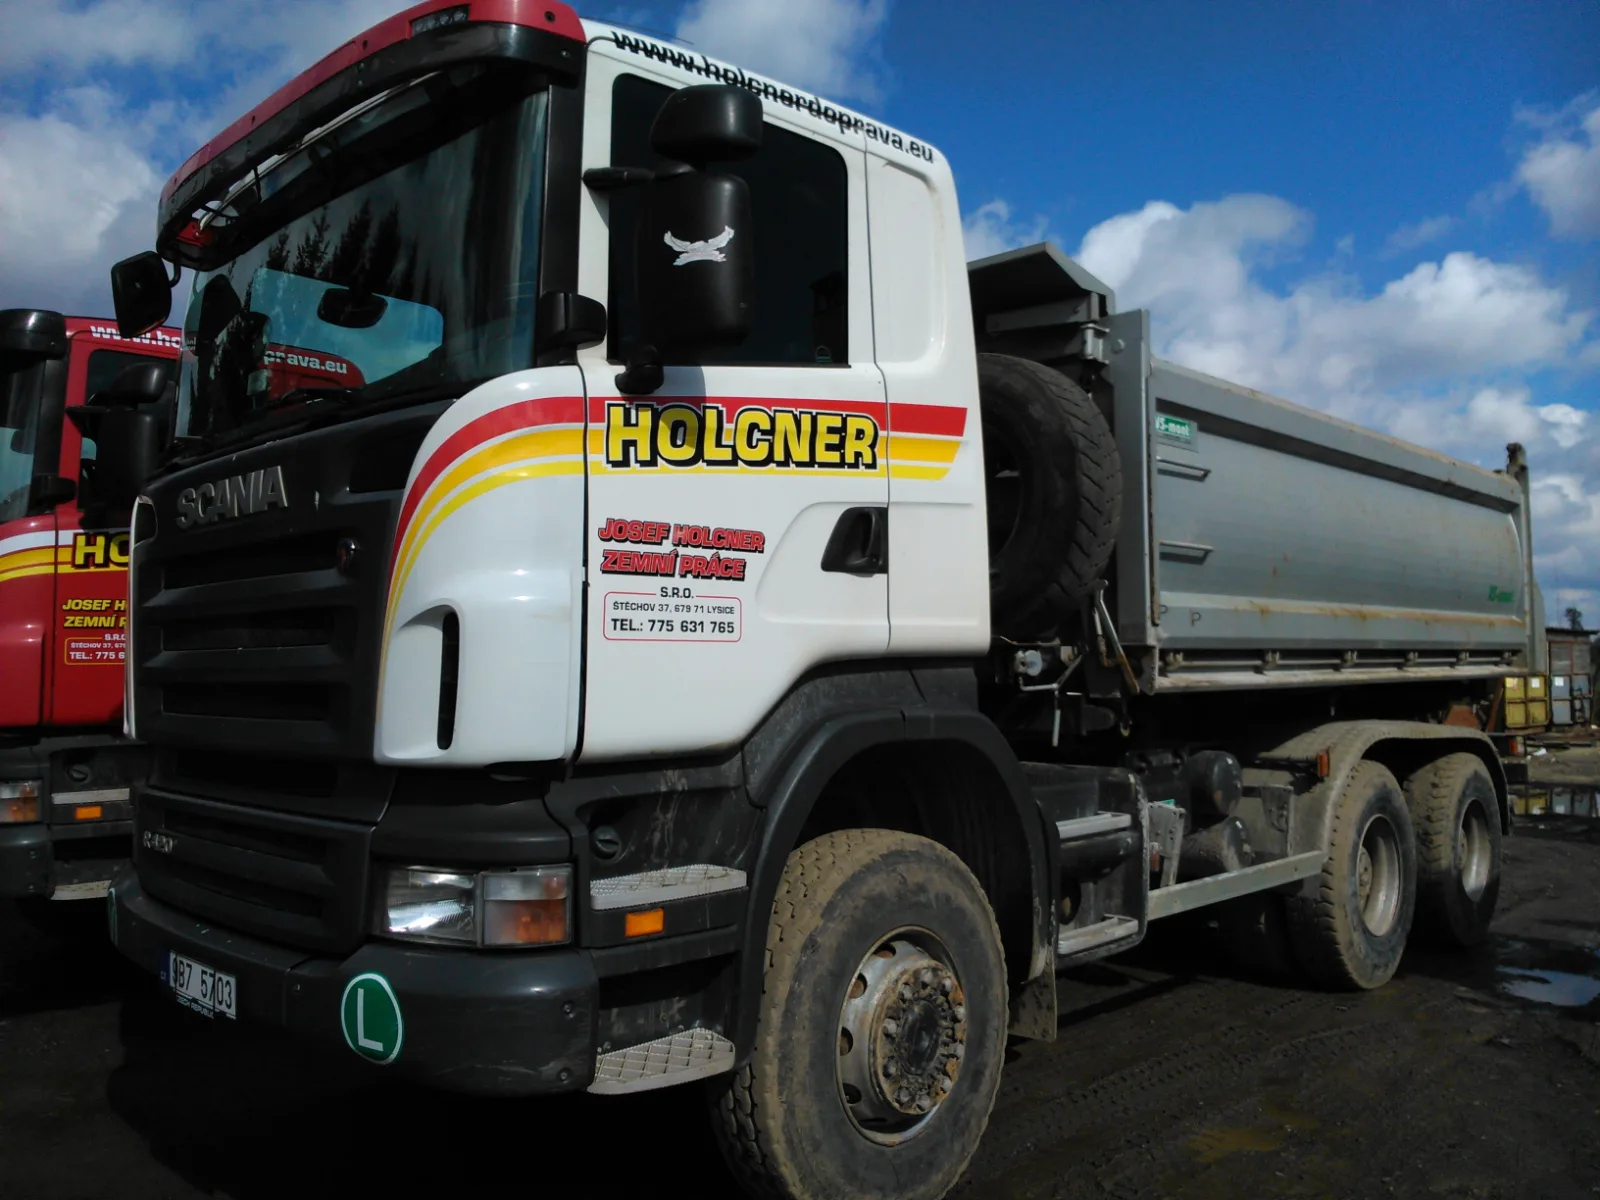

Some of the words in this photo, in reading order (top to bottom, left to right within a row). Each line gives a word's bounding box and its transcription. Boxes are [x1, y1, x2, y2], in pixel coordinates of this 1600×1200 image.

[610, 30, 934, 164] www.holcnerdoprava.eu
[604, 403, 878, 470] HOLCNER
[176, 465, 288, 529] SCANIA
[598, 518, 670, 546] JOSEF
[672, 524, 765, 554] HOLCNER
[600, 549, 679, 578] ZEMNÍ
[679, 552, 747, 581] PRÁCE
[660, 586, 694, 599] S.R.O.
[62, 599, 112, 612] JOSEF
[612, 600, 656, 612] ŠTĚCHOV
[658, 604, 672, 613] 37,
[674, 604, 691, 613] 679
[694, 605, 704, 614] 71
[707, 606, 735, 615] LYSICE
[63, 614, 117, 628] ZEMNÍ
[611, 618, 643, 632] TEL.:
[648, 619, 674, 632] 775
[680, 620, 704, 633] 631
[710, 621, 735, 634] 765
[95, 651, 115, 660] 775
[357, 987, 384, 1051] L
